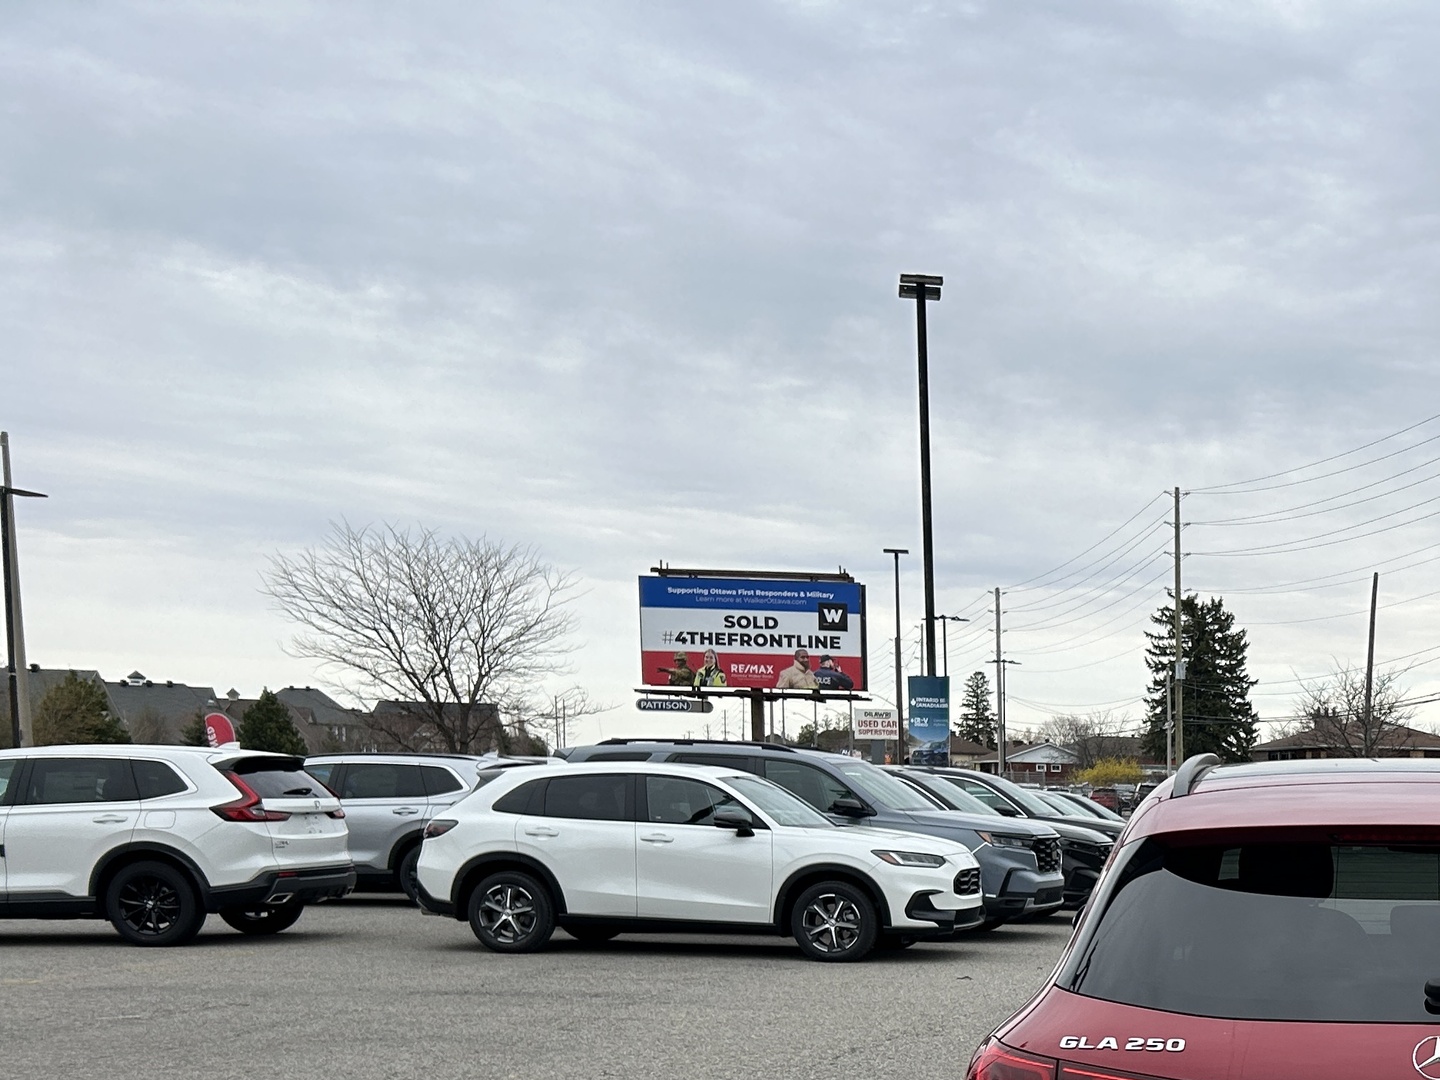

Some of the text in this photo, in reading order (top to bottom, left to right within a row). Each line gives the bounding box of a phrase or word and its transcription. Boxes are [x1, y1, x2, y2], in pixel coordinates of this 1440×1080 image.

[667, 587, 709, 596] Supporting
[755, 589, 798, 597] Responders
[806, 591, 834, 599] Military
[743, 597, 807, 605] WalkerOttawa.com
[823, 608, 843, 623] W
[723, 615, 779, 630] SOLD
[661, 630, 841, 650] #4THEFRONTLINE
[730, 664, 774, 674] RE/MAX
[815, 676, 831, 685] OLICE
[640, 701, 687, 710] PATTISON
[857, 720, 897, 728] USED CAR
[1059, 1035, 1187, 1052] GLA 250
